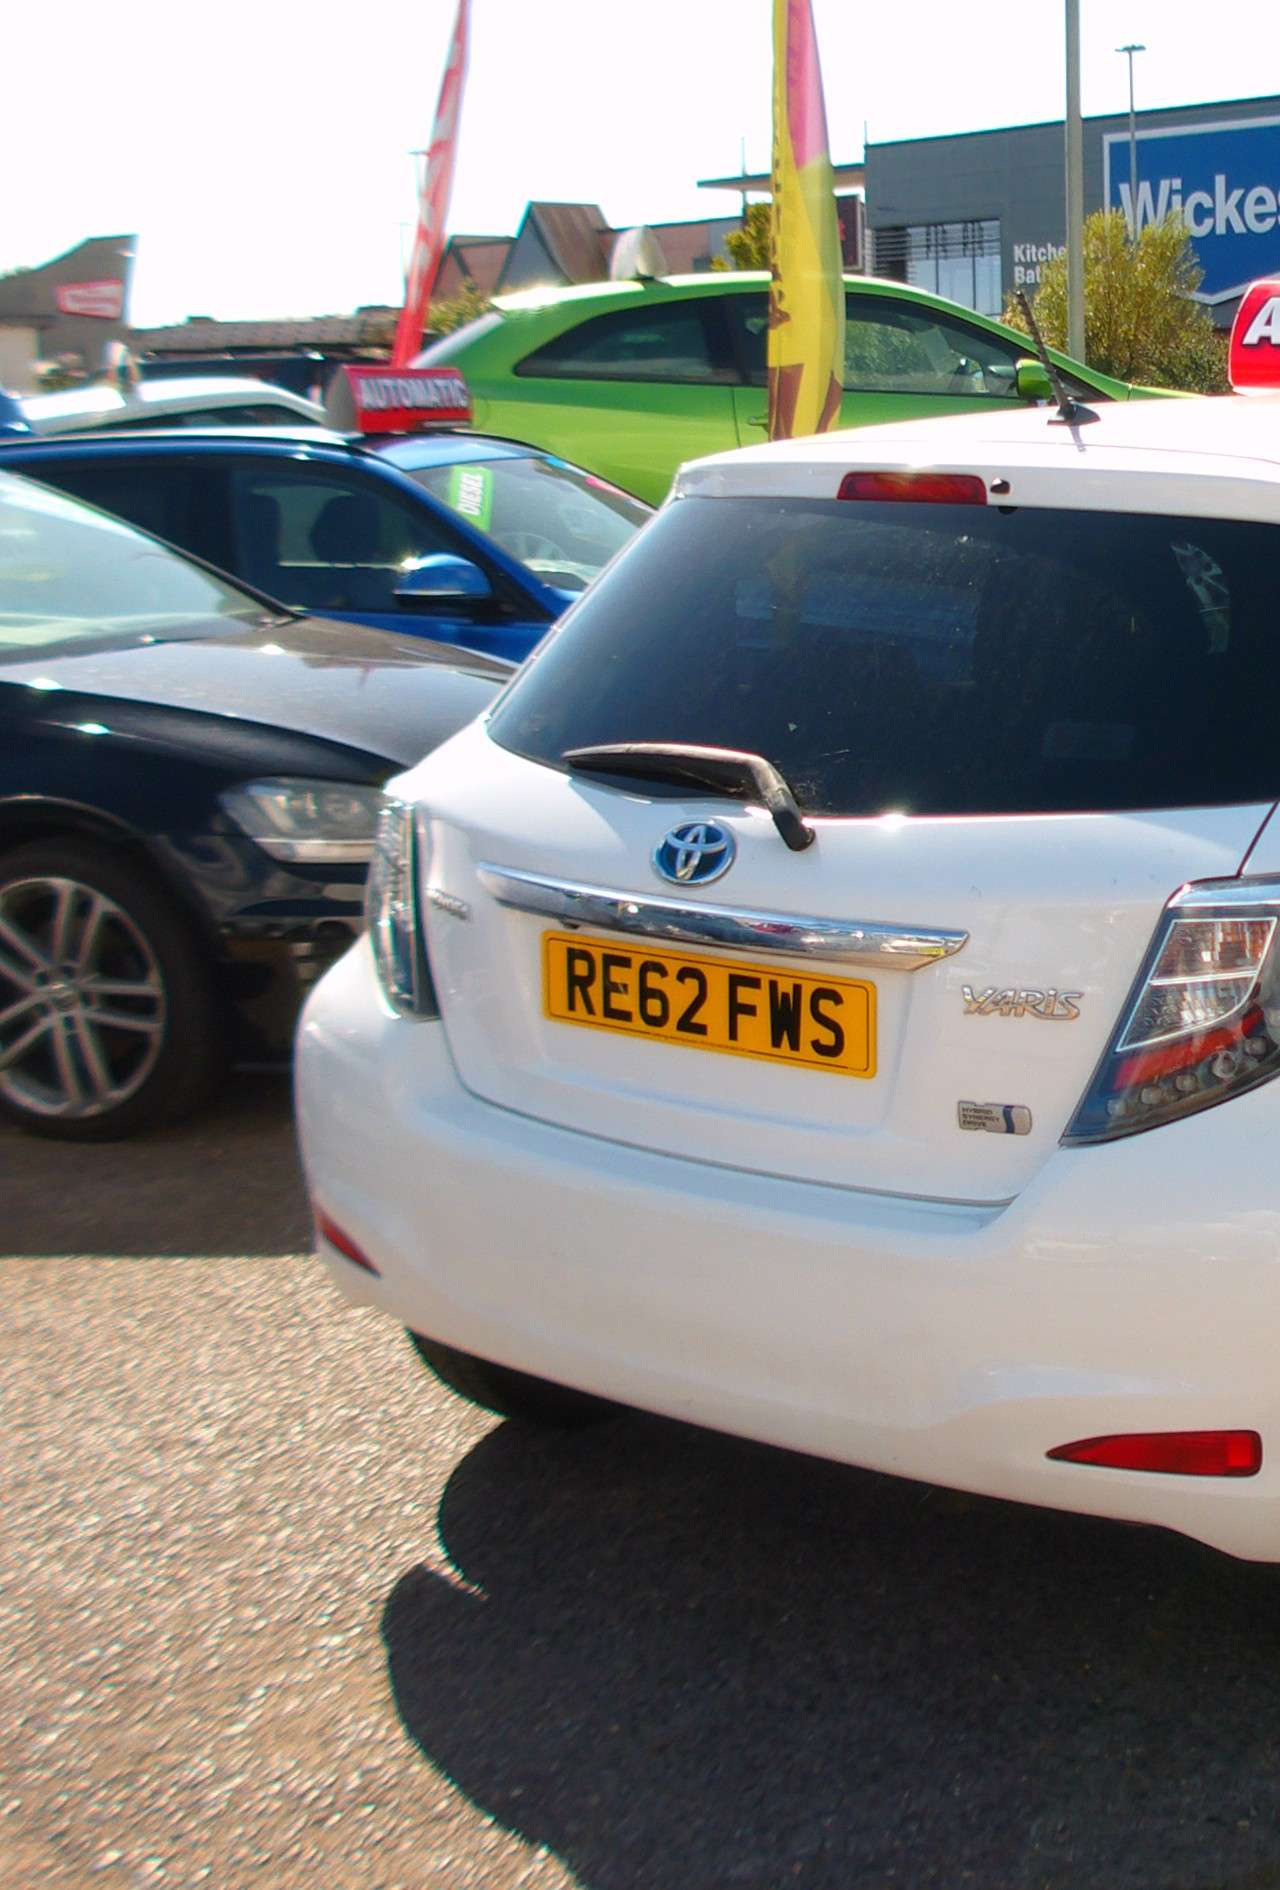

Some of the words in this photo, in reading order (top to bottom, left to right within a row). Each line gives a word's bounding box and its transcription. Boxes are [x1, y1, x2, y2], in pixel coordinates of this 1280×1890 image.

[359, 377, 469, 408] AUTOMATIC
[566, 947, 708, 1036] RE62
[728, 973, 845, 1058] FWS
